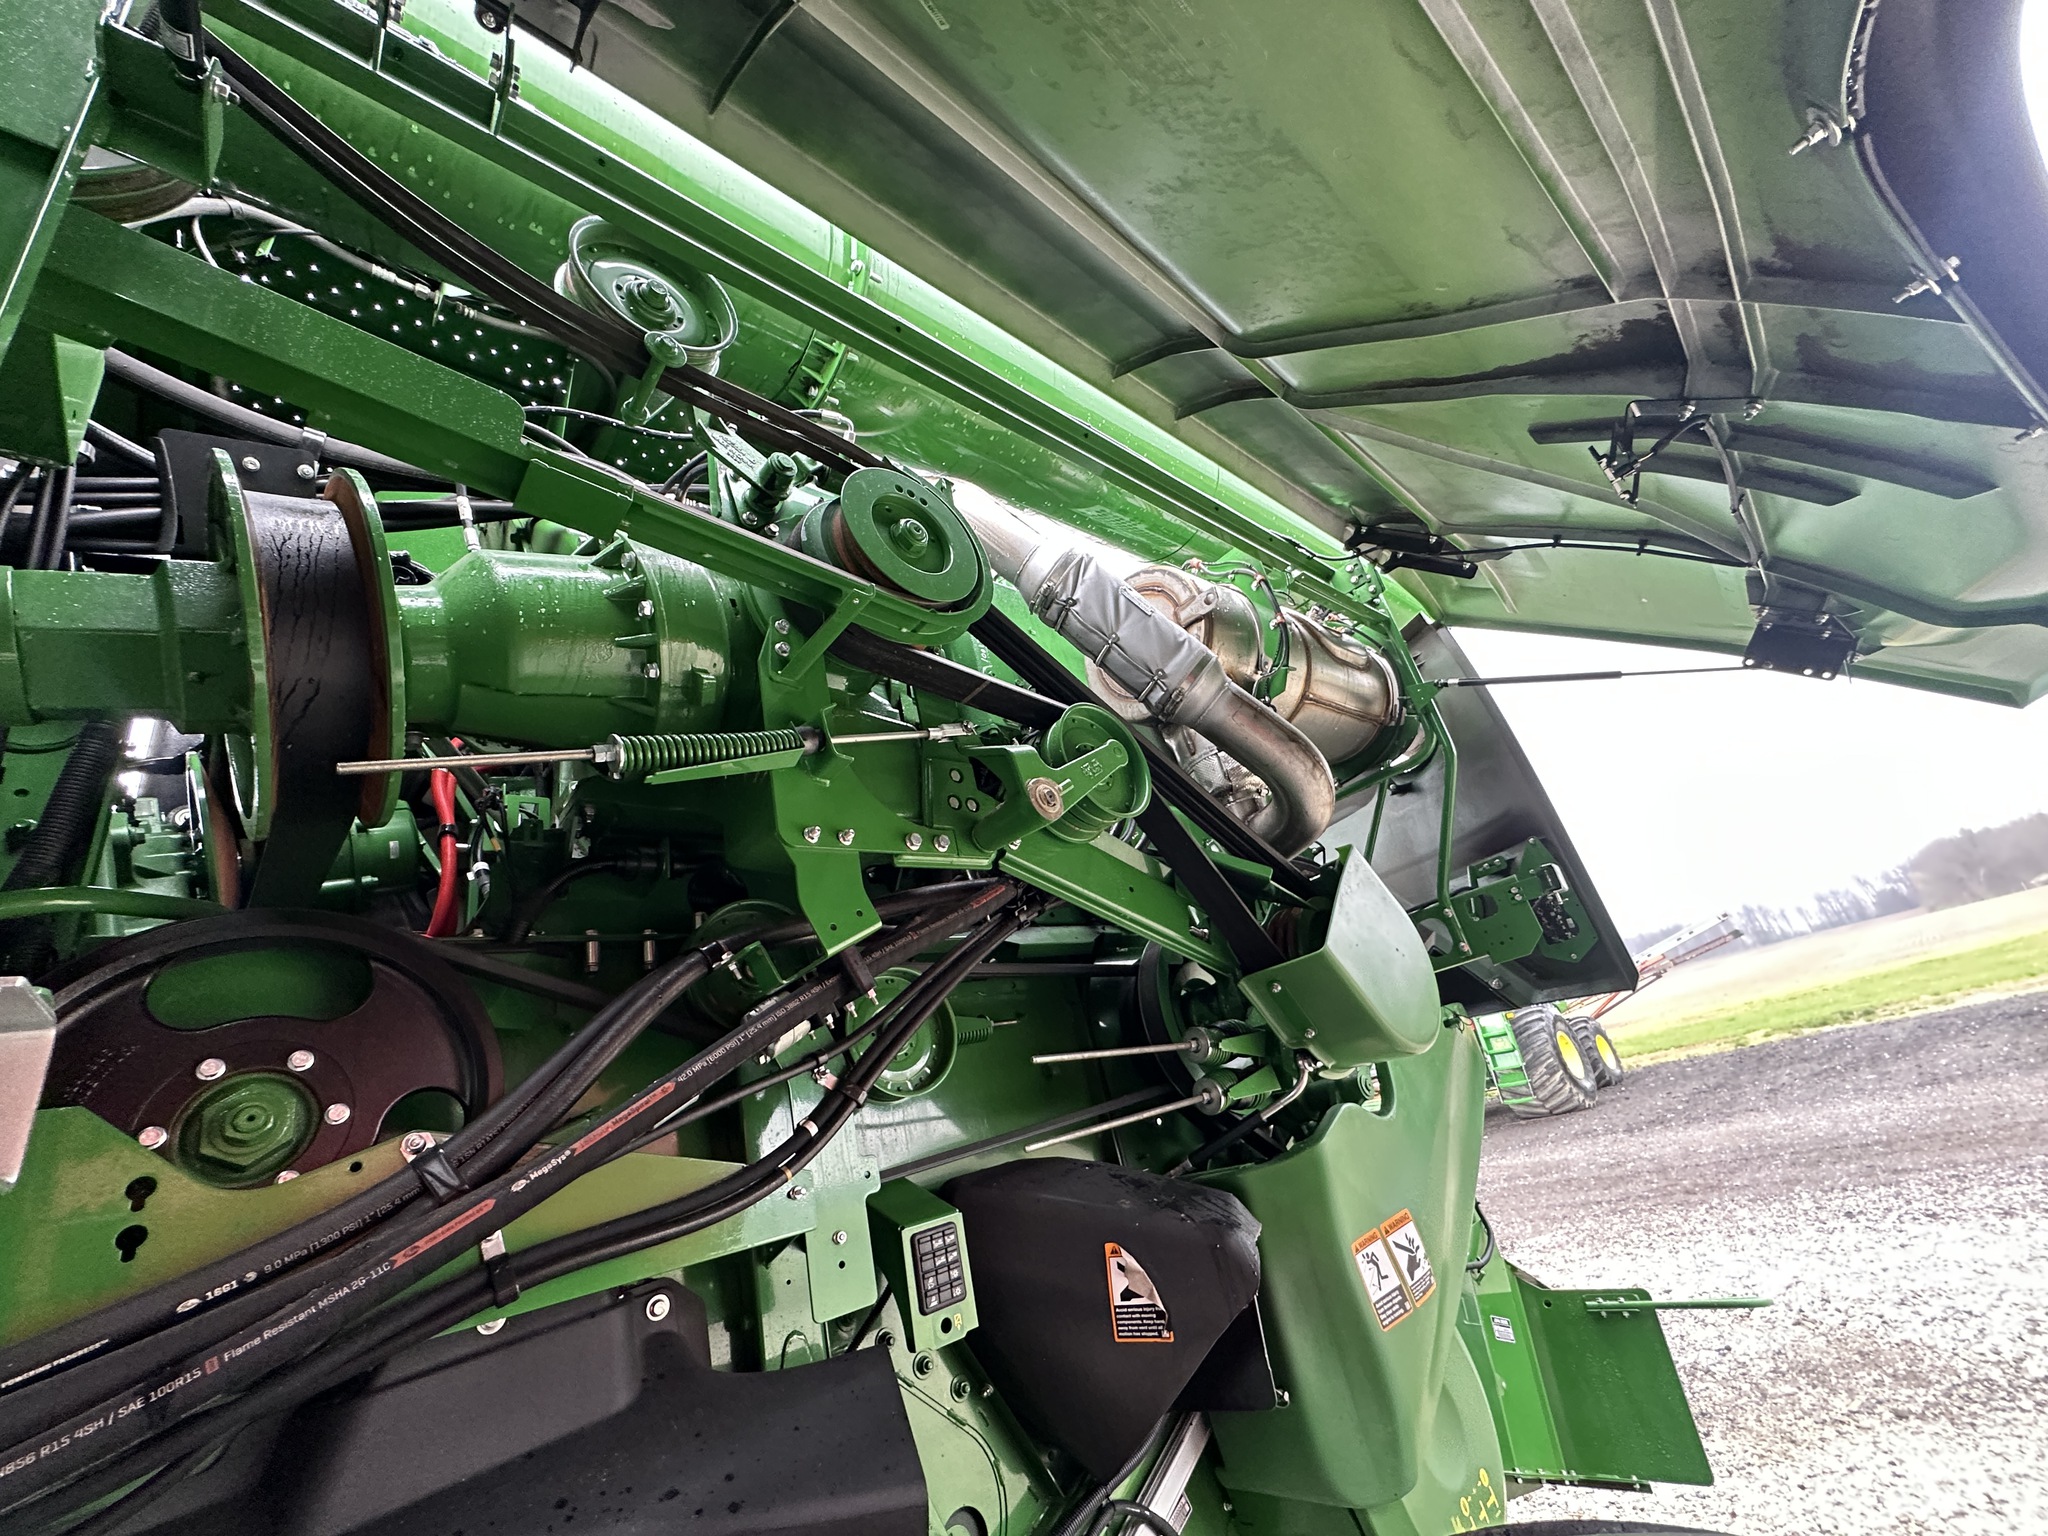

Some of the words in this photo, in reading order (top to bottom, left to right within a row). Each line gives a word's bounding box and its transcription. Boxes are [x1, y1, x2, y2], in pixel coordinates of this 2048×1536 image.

[677, 1069, 693, 1083] 42.0
[692, 1060, 708, 1074] MPa
[775, 1006, 787, 1018] ISO
[1387, 1212, 1410, 1231] WARNING
[1357, 1231, 1378, 1249] WARNING
[263, 1259, 283, 1274] 9.0
[283, 1249, 309, 1265] MPa
[40, 1434, 71, 1458] R15
[73, 1417, 105, 1439] 4SH
[107, 1411, 115, 1426] /
[117, 1397, 146, 1419] SAE
[148, 1366, 202, 1403] 100R15
[223, 1336, 262, 1362] Flame
[262, 1305, 317, 1340] Resistant
[317, 1286, 351, 1310] MSHA
[350, 1261, 392, 1290] 2G-11C
